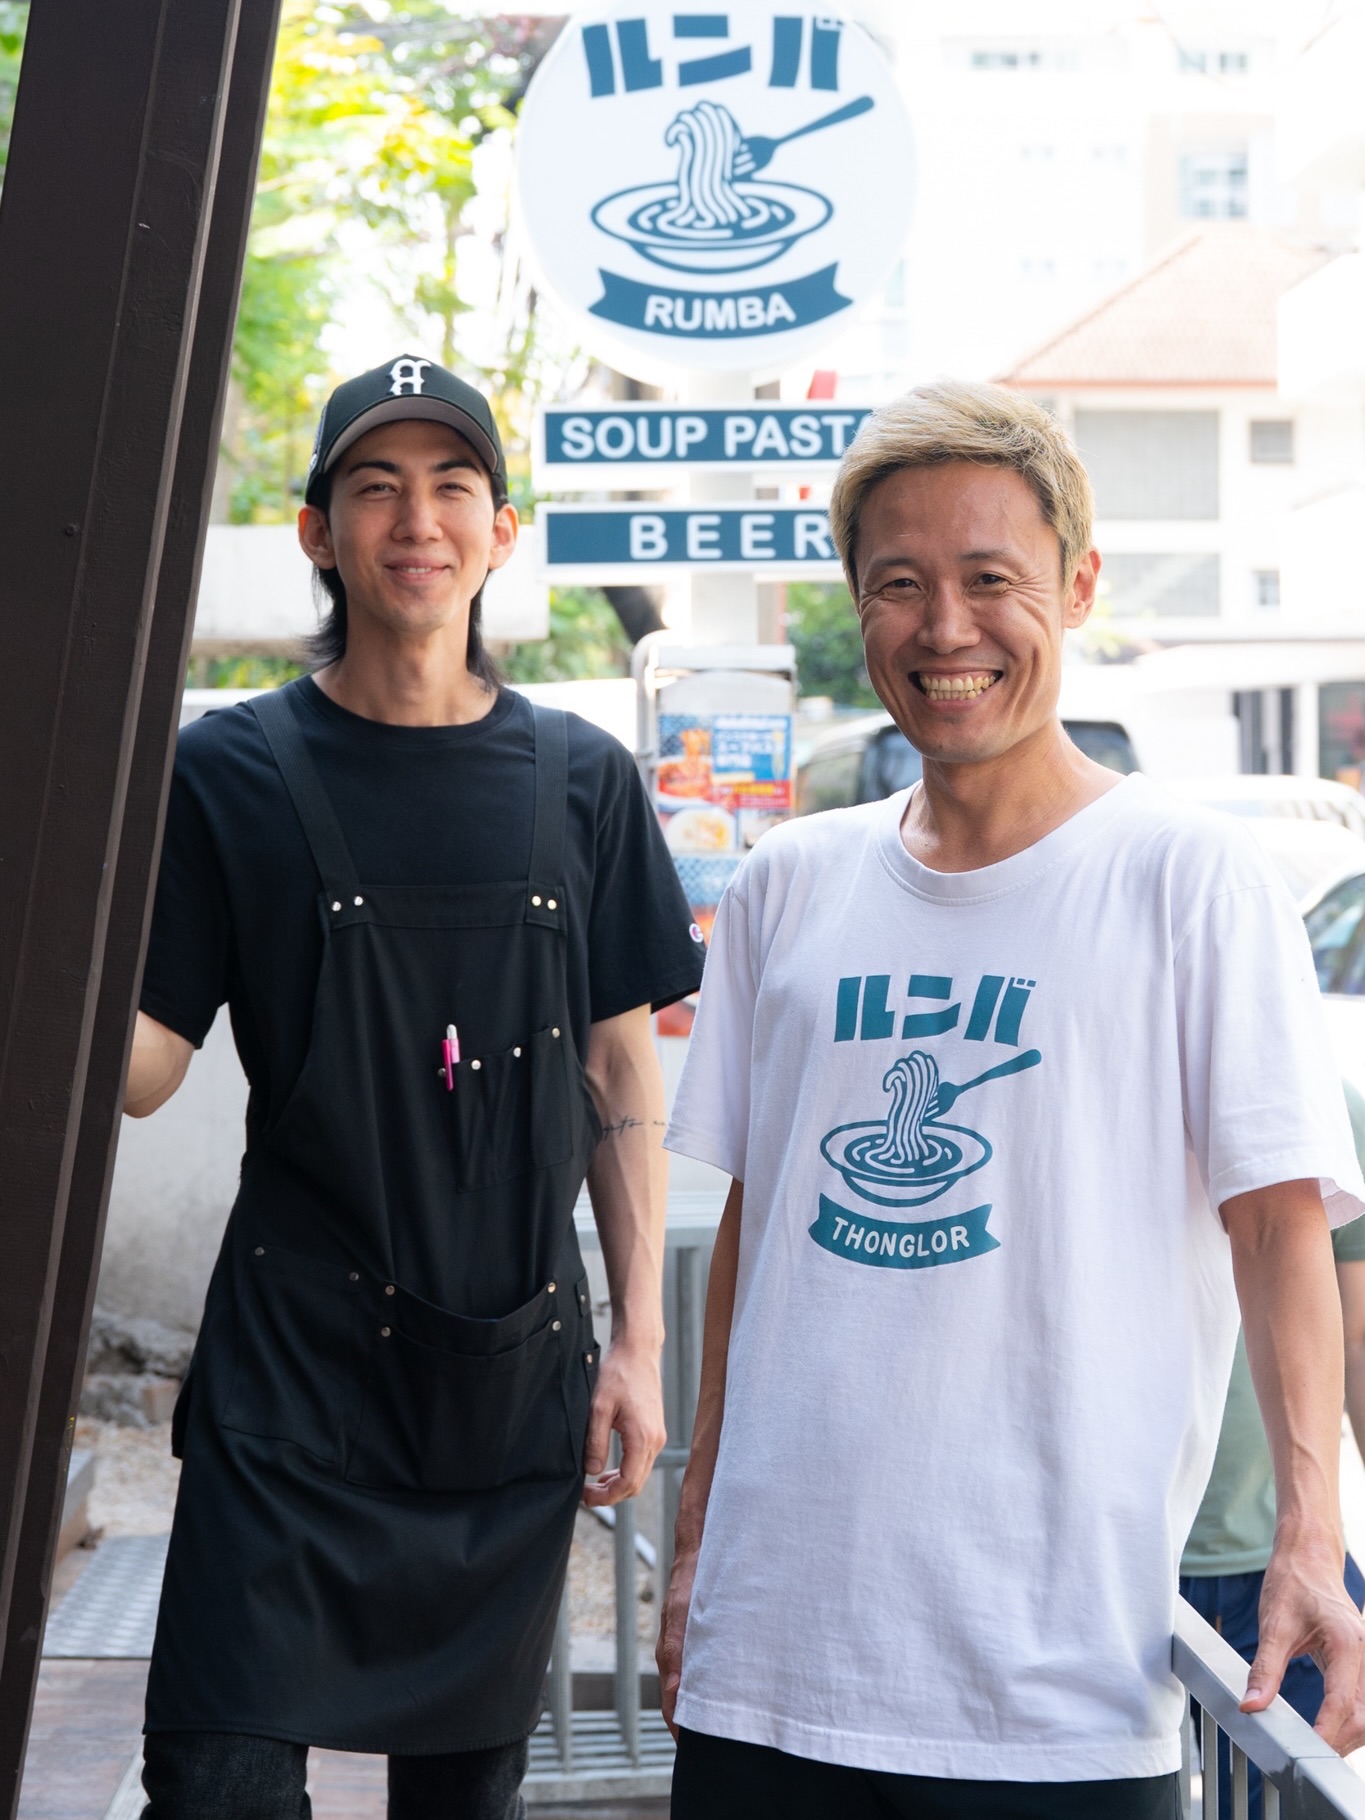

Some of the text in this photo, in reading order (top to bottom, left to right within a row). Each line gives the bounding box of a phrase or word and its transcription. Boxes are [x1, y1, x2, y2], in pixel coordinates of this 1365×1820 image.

[581, 14, 844, 98] ルンバ
[644, 293, 796, 331] RUMBA
[561, 415, 870, 458] SOUP PAST
[630, 514, 833, 560] BEER
[834, 975, 1037, 1047] ルンバ
[832, 1216, 970, 1258] THONGLOR
